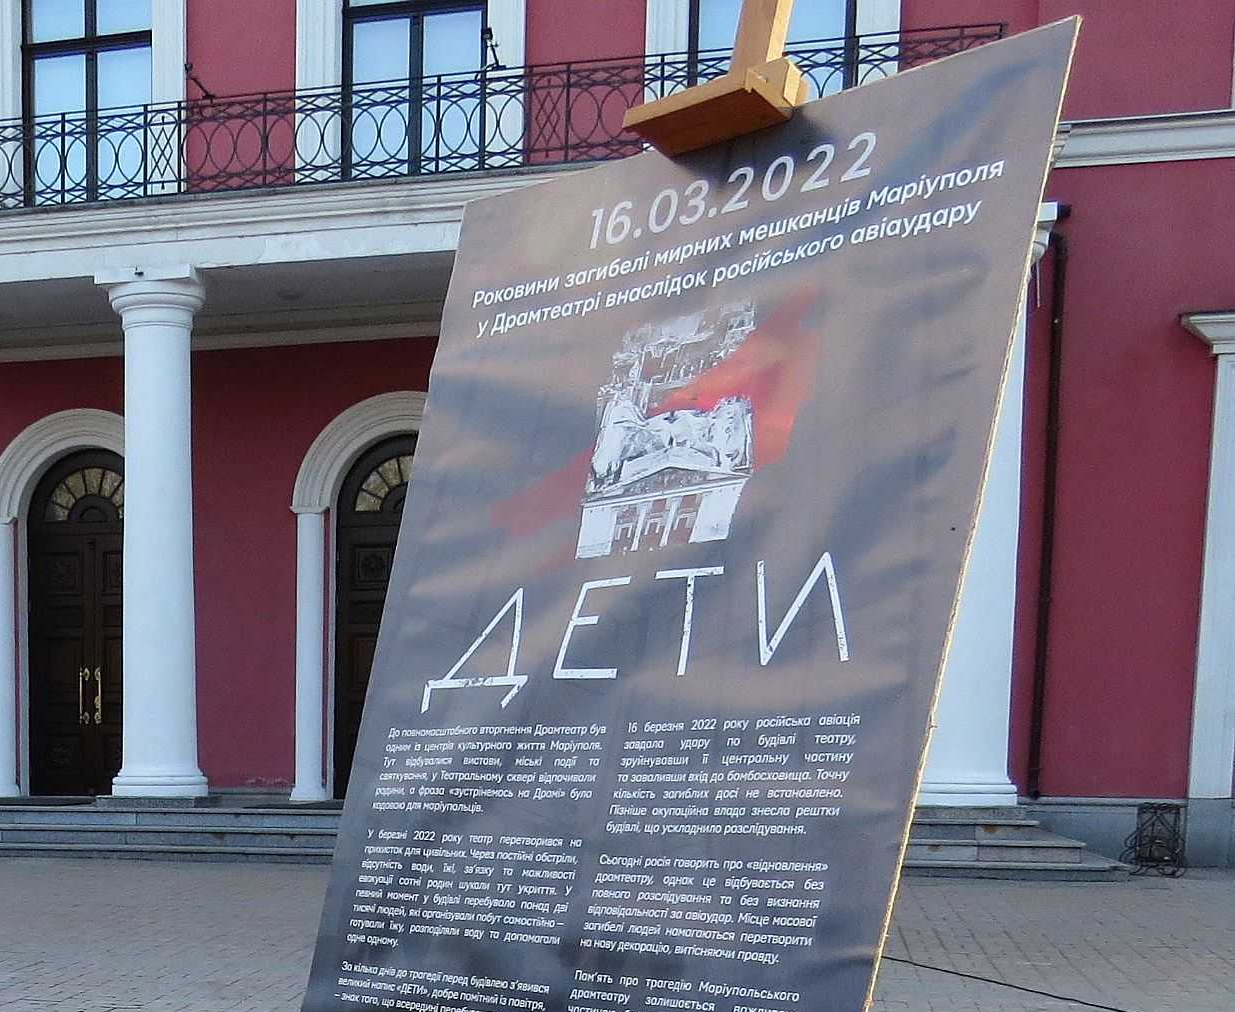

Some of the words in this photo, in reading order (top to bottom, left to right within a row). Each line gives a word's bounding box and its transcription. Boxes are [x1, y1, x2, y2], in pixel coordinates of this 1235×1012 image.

[589, 131, 877, 250] 16.03.2022
[471, 275, 560, 309] Роковини
[564, 250, 654, 288] загибелі
[653, 232, 734, 271] мирних
[738, 198, 862, 245] мешканців
[866, 159, 1005, 211] Маріуполя
[475, 320, 490, 339] у
[490, 291, 604, 335] Драмтеатрі
[604, 268, 710, 308] внаслідок
[712, 232, 845, 287] російського
[850, 199, 981, 246] авіаудару
[420, 552, 850, 714] ДЕТИ
[627, 720, 638, 733] 16
[644, 720, 685, 735] березня
[690, 718, 717, 730] 2022
[723, 719, 750, 731] року
[818, 712, 860, 728] авіація
[679, 738, 710, 751] удару
[726, 737, 741, 747] по
[757, 733, 797, 748] будівлі
[701, 753, 710, 764] її
[804, 753, 853, 766] частину
[617, 774, 630, 784] та
[686, 769, 709, 784] вхід
[708, 771, 727, 784] до
[816, 768, 849, 783] Точну
[662, 787, 710, 800] загиблих
[715, 787, 738, 802] досі
[745, 789, 760, 799] не
[608, 803, 648, 815] Пізніше
[713, 806, 746, 819] влада
[750, 806, 791, 816] знесла
[795, 806, 840, 819] рештки
[643, 824, 661, 835] що
[597, 853, 643, 868] Сьогодні
[643, 855, 674, 870] росія
[671, 858, 720, 871] говорить
[723, 859, 743, 872] про
[663, 876, 694, 889] однак
[702, 877, 716, 890] це
[804, 878, 825, 890] без
[590, 889, 631, 901] повного
[720, 896, 732, 906] та
[739, 894, 759, 907] без
[766, 897, 821, 909] визнання
[583, 919, 626, 933] загибелі
[626, 923, 664, 938] людей
[668, 910, 683, 920] за
[737, 912, 773, 929] Місце
[771, 914, 816, 928] масової
[579, 939, 593, 948] на
[592, 939, 617, 952] нову
[619, 975, 639, 989] про
[645, 978, 694, 994] трагедію
